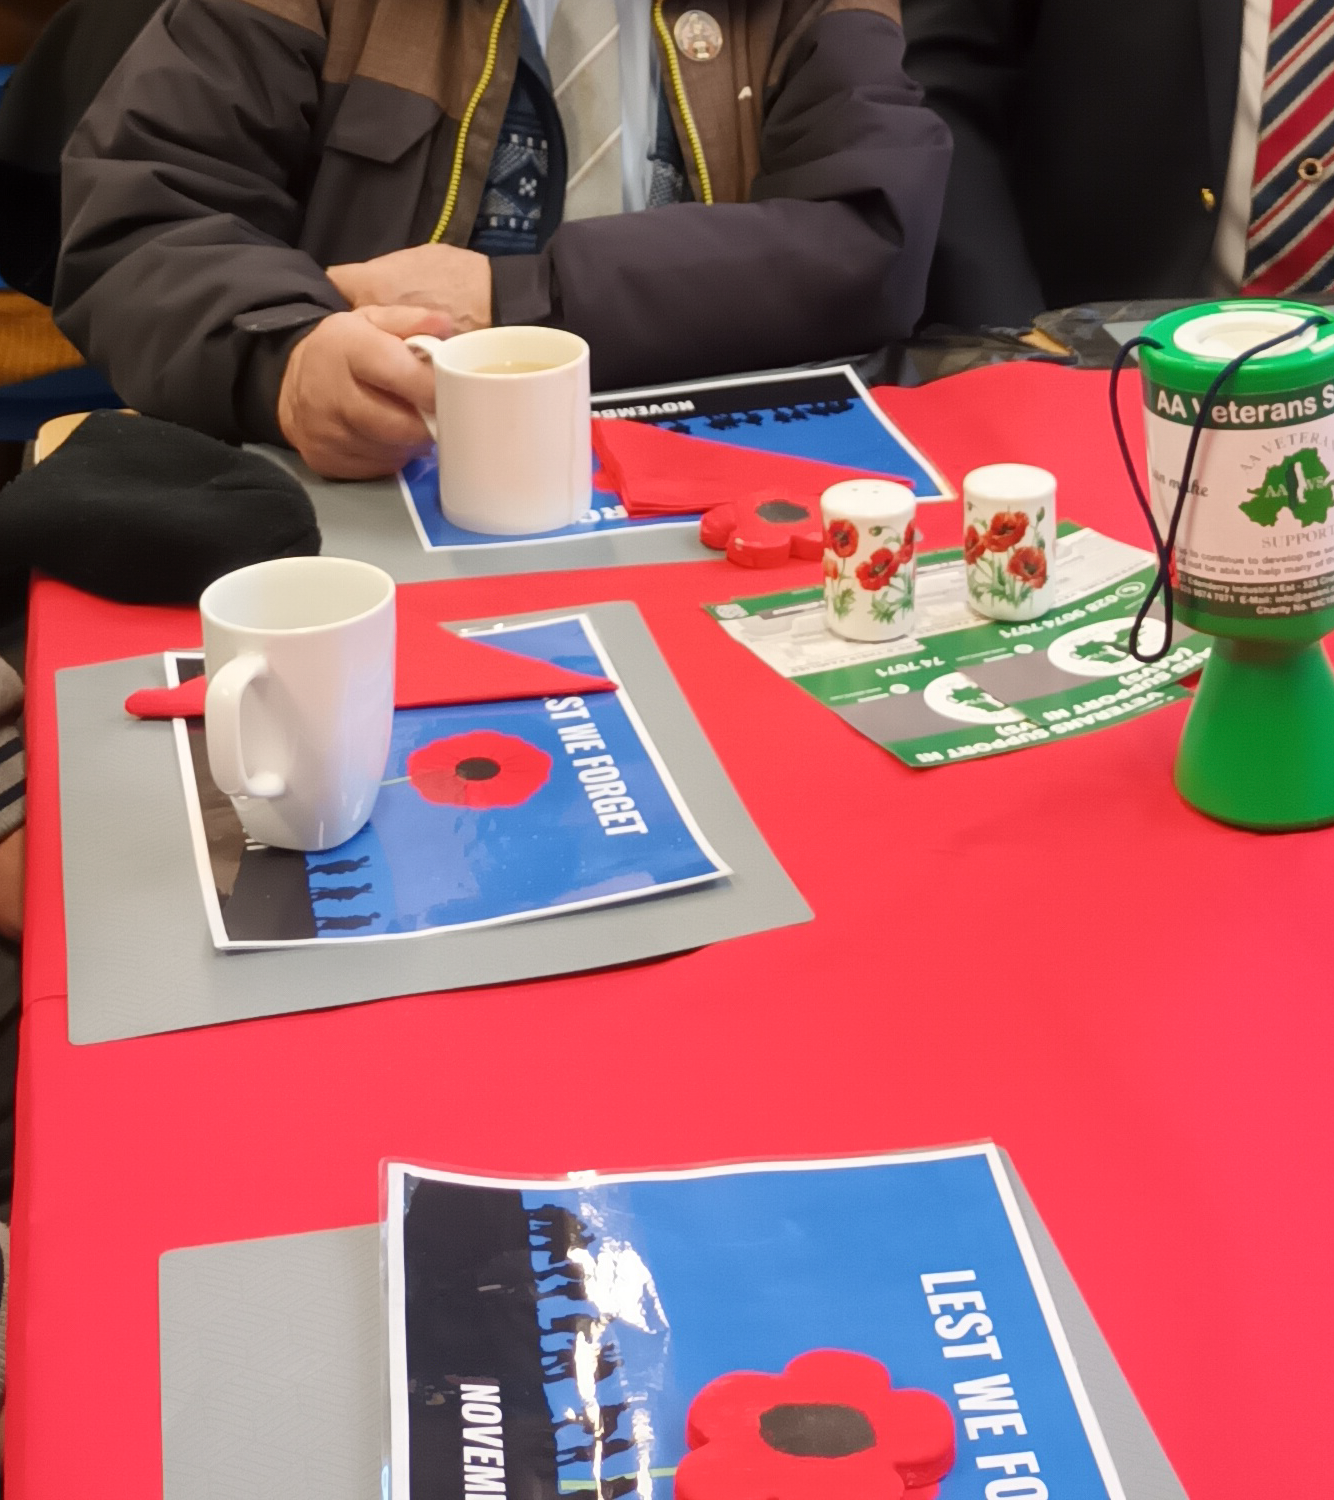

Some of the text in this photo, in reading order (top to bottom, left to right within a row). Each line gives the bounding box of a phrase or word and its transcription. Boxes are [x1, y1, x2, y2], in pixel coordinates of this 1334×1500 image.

[1156, 390, 1188, 419] AA
[1049, 690, 1165, 735] VETERANS
[557, 722, 607, 755] WE
[946, 728, 1050, 759] SUPPORT
[571, 754, 650, 838] FORGET
[920, 1269, 1050, 1500] LEST WE FO
[458, 1382, 508, 1500] NOVEM
